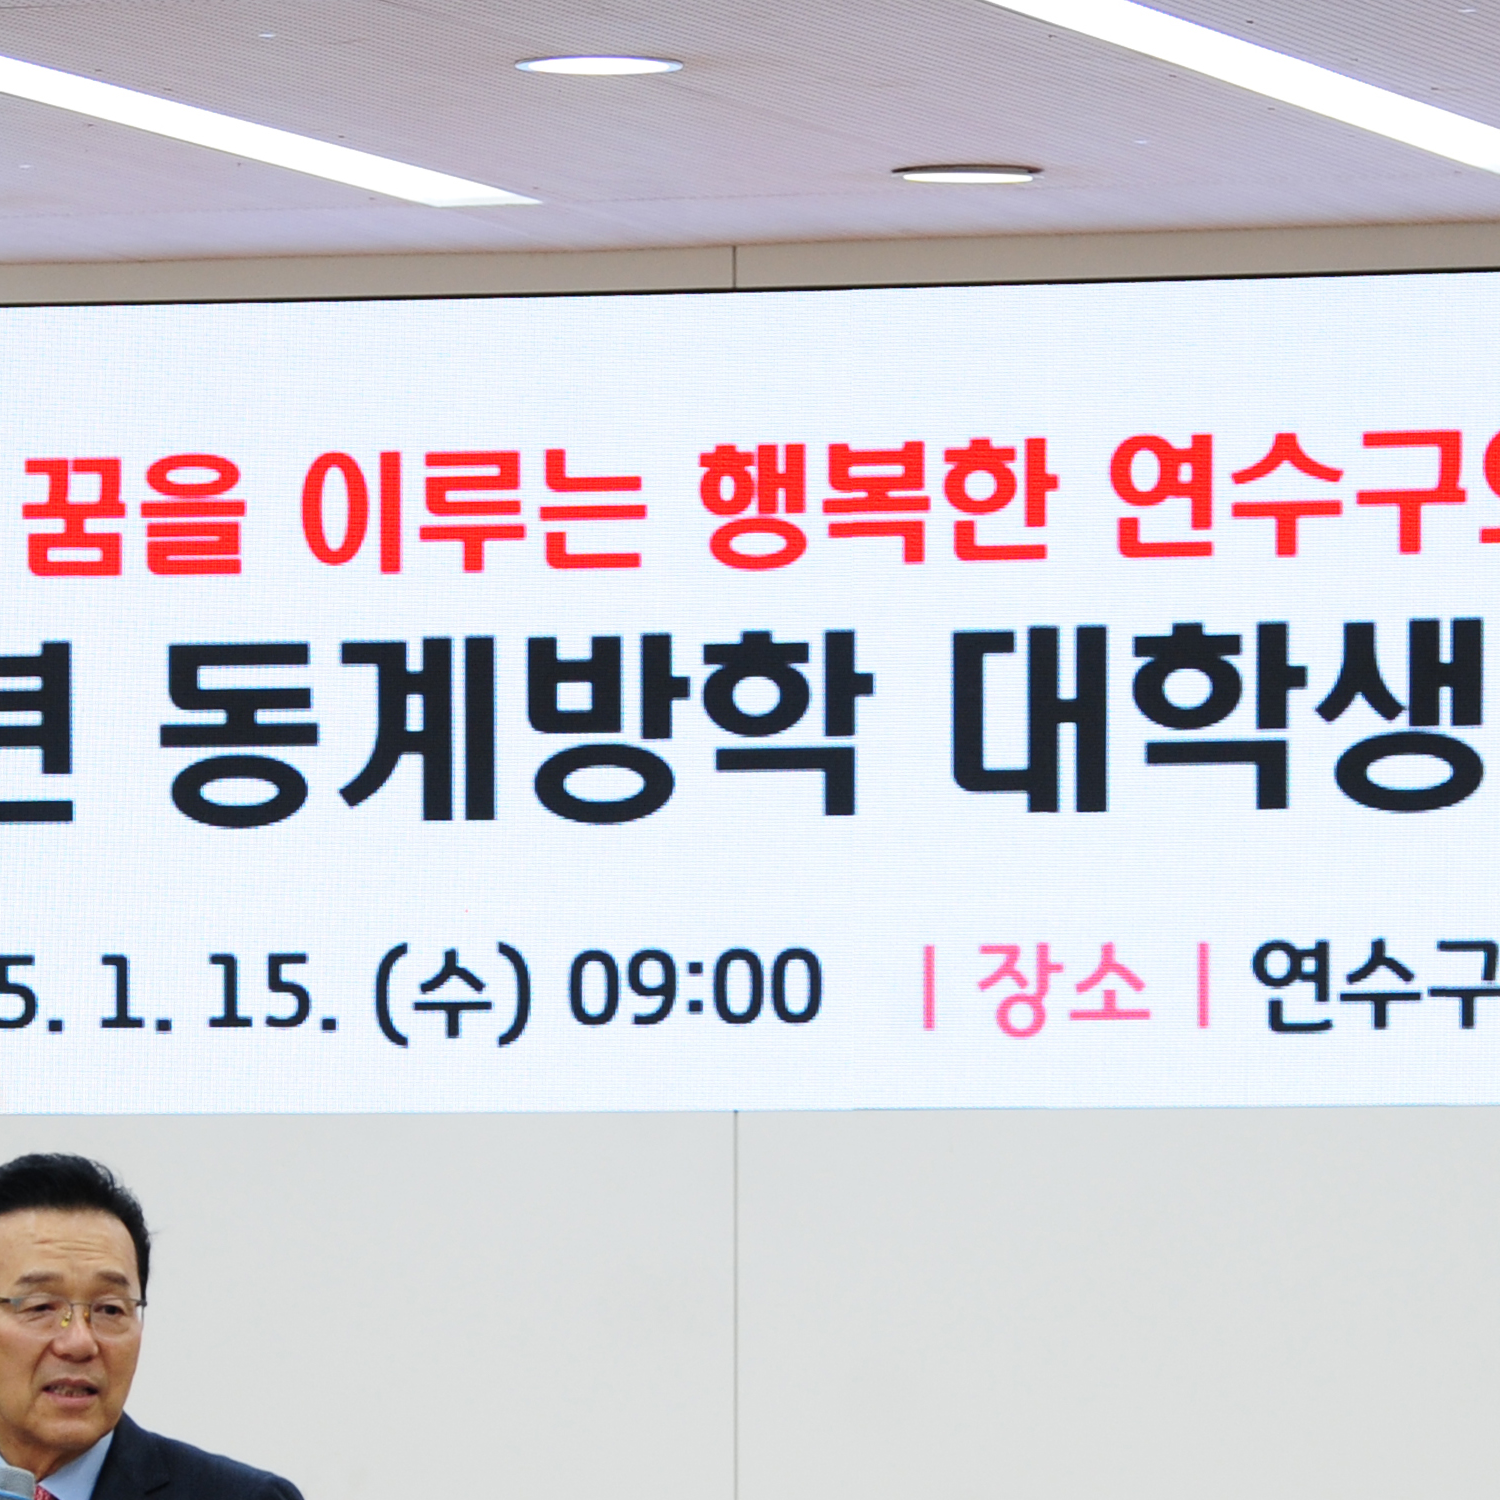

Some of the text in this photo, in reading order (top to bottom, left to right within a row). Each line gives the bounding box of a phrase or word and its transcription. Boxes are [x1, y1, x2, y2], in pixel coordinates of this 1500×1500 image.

[21, 452, 249, 578] 꿈을
[301, 449, 650, 576] 이루는
[698, 437, 1061, 573] 행복한
[160, 631, 876, 830] 동계방학
[953, 619, 1486, 814] 대학생
[101, 954, 173, 1034] 1.
[209, 953, 338, 1033] 15.
[375, 941, 533, 1048] (수)
[569, 948, 824, 1028] 09:00
[977, 941, 1154, 1040] 장소
